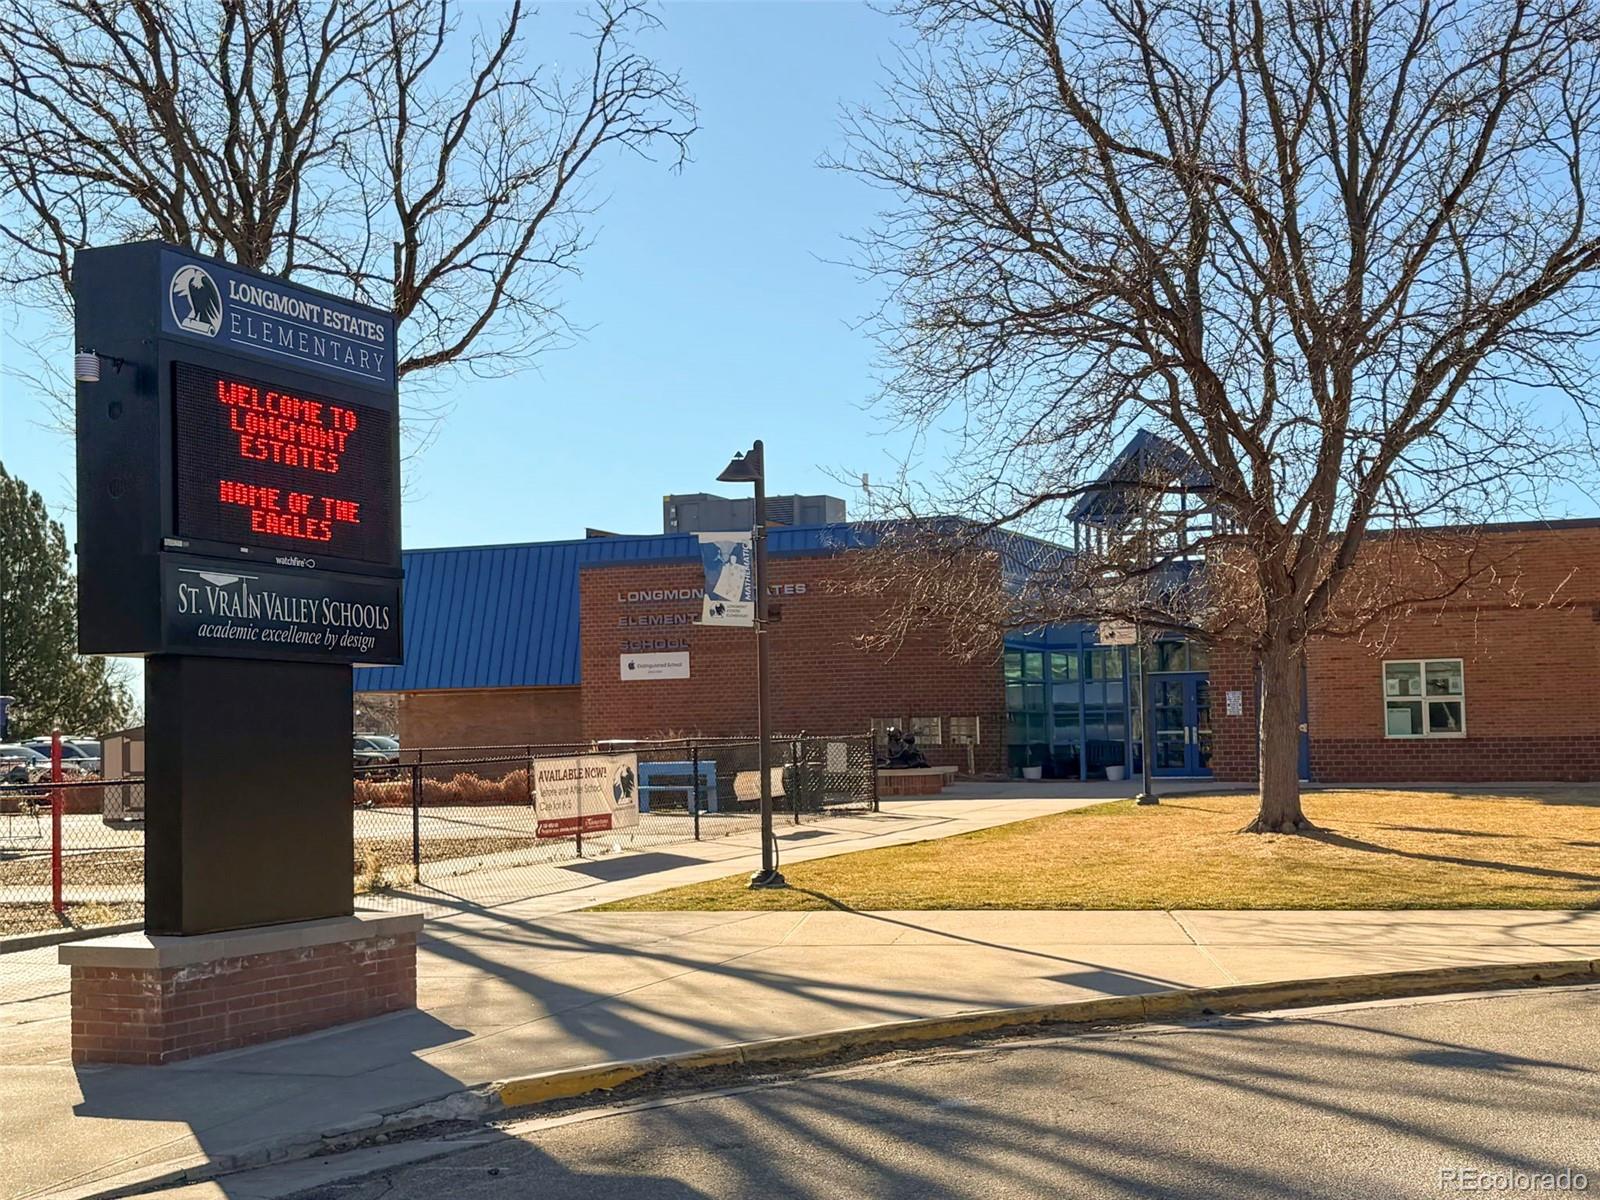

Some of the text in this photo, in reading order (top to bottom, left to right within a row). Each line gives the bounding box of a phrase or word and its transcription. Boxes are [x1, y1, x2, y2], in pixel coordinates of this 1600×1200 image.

[229, 279, 385, 342] LONGMONT ESTATES
[231, 313, 386, 373] ELEMENTARY
[218, 380, 358, 432] WELCOME TO
[231, 409, 348, 452] LONGMONT
[240, 435, 340, 474] ESTATES
[219, 479, 360, 523] HOME OF THE
[252, 509, 332, 542] EAGLES
[178, 583, 203, 615] ST.
[262, 591, 319, 625] VALLEY
[322, 597, 390, 631] SCHOOLS
[617, 588, 704, 602] LONGMON
[198, 620, 376, 653] academic excellence by design
[618, 612, 699, 626] ELEMENT
[619, 639, 689, 650] SCHOOL
[538, 766, 607, 783] AVAILABLE NOW!
